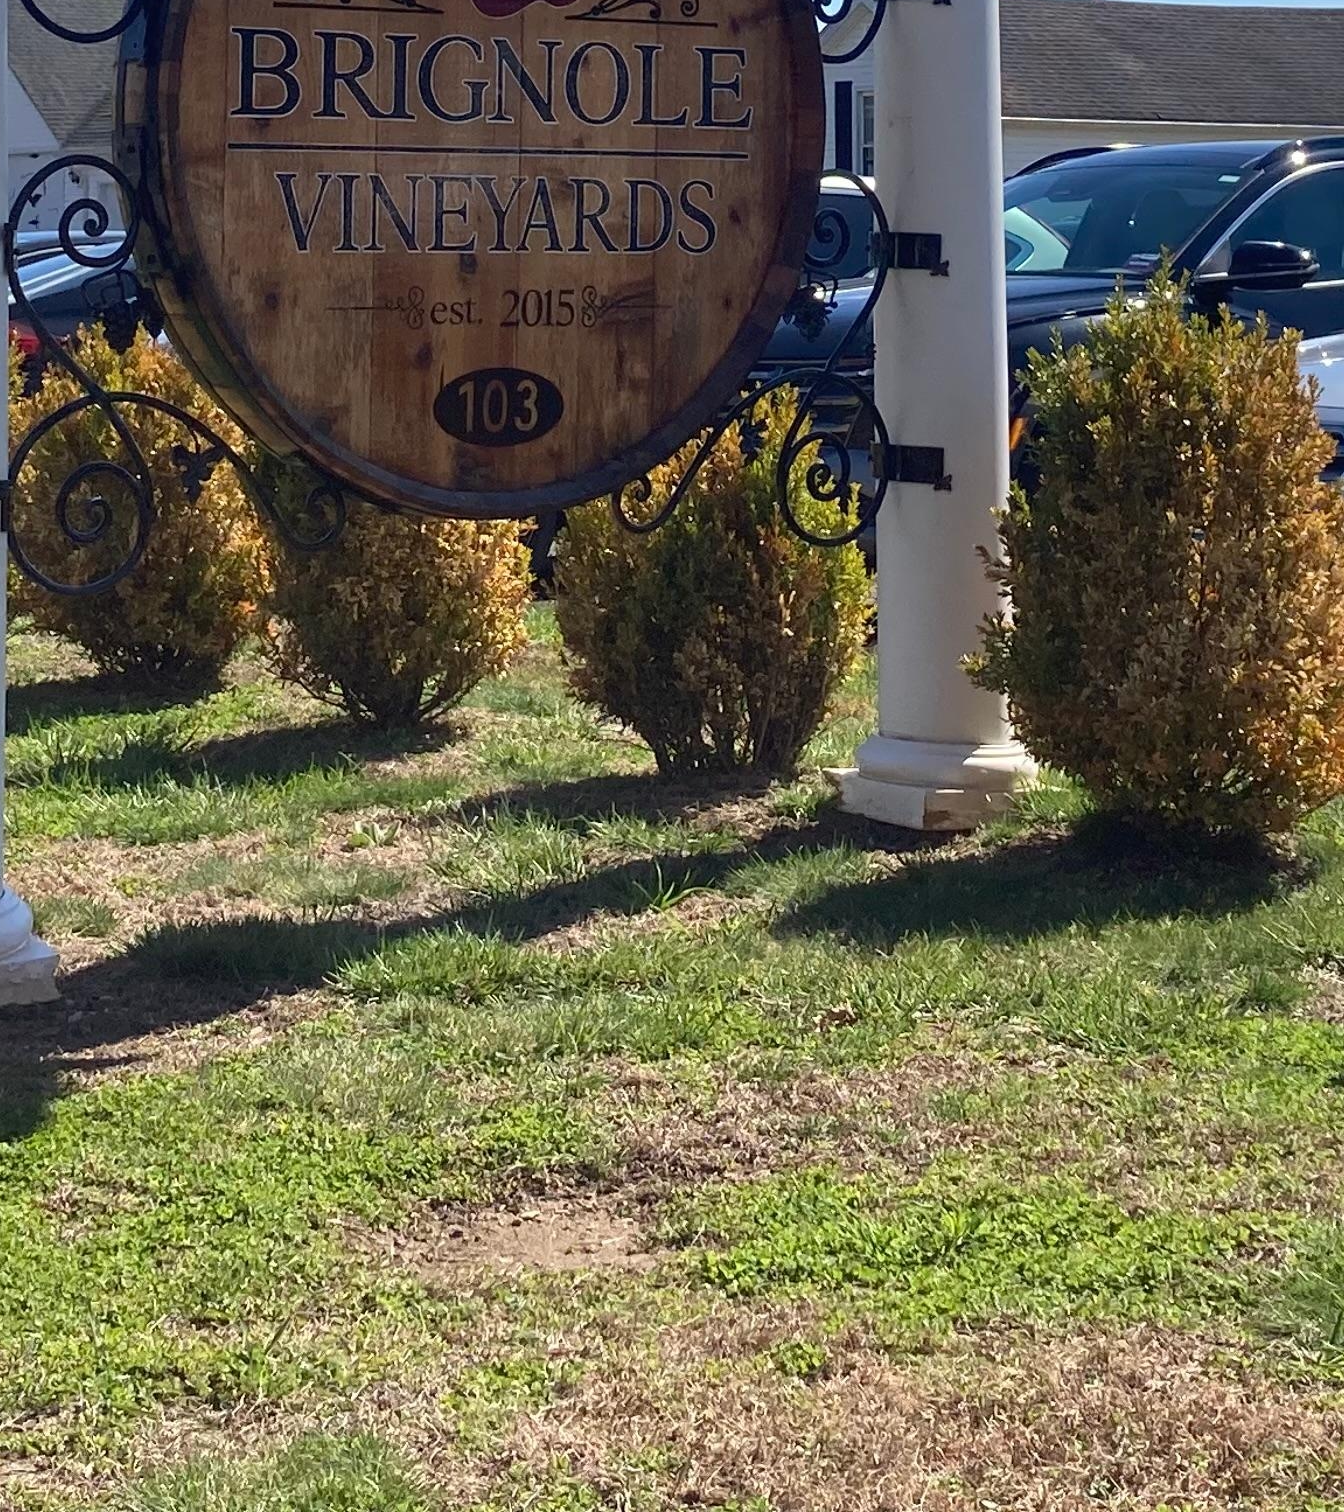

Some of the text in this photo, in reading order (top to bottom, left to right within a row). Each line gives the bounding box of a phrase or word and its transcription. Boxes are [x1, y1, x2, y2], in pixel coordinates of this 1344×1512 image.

[229, 26, 753, 130] BRIGNOLE
[274, 172, 718, 255] VINEYARDS
[430, 289, 575, 327] est. 2015
[458, 379, 540, 433] 103
